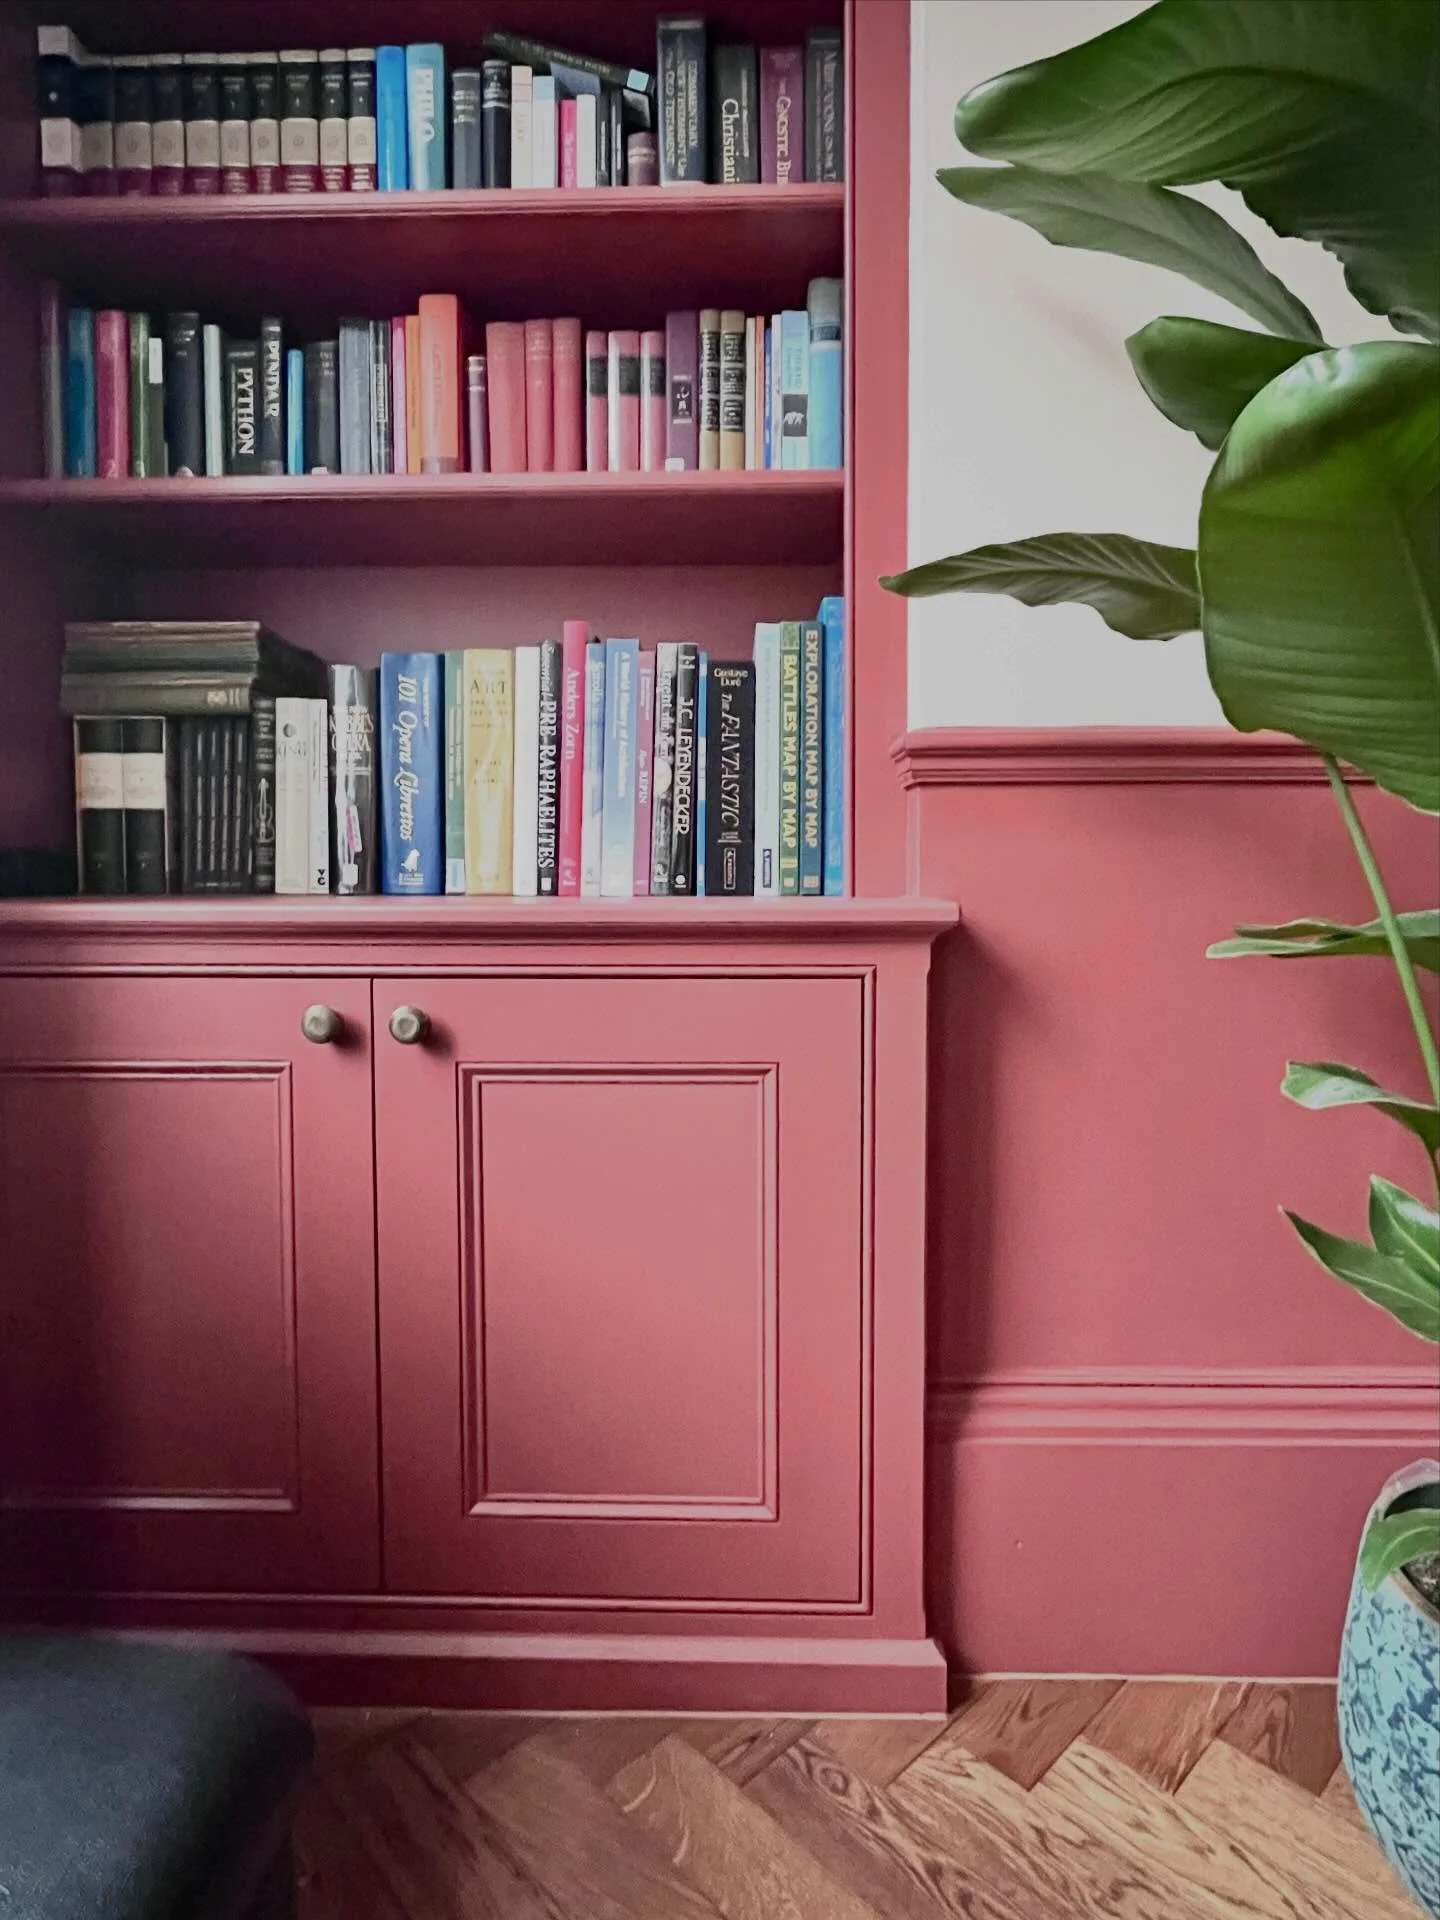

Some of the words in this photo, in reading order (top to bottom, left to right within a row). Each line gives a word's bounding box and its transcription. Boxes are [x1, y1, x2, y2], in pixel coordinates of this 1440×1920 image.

[263, 340, 281, 418] PINDAR
[236, 367, 255, 456] PYTHON
[397, 673, 418, 704] 101
[565, 667, 580, 720] Anders
[783, 653, 798, 731] BATTLES
[804, 629, 819, 746] EXPLORATION
[393, 710, 419, 763] Opera
[565, 723, 579, 760] Zorn
[782, 736, 797, 777] MAP
[538, 699, 557, 868] PRE-RAPHAELITES
[676, 727, 692, 835] LEYENDECKER
[720, 711, 742, 828] FANTASTIC
[782, 781, 797, 805] BY
[804, 750, 818, 785] MAP
[393, 767, 420, 841] Librettos
[804, 788, 817, 810] BY
[782, 808, 797, 848] MAP
[804, 812, 818, 848] MAP
